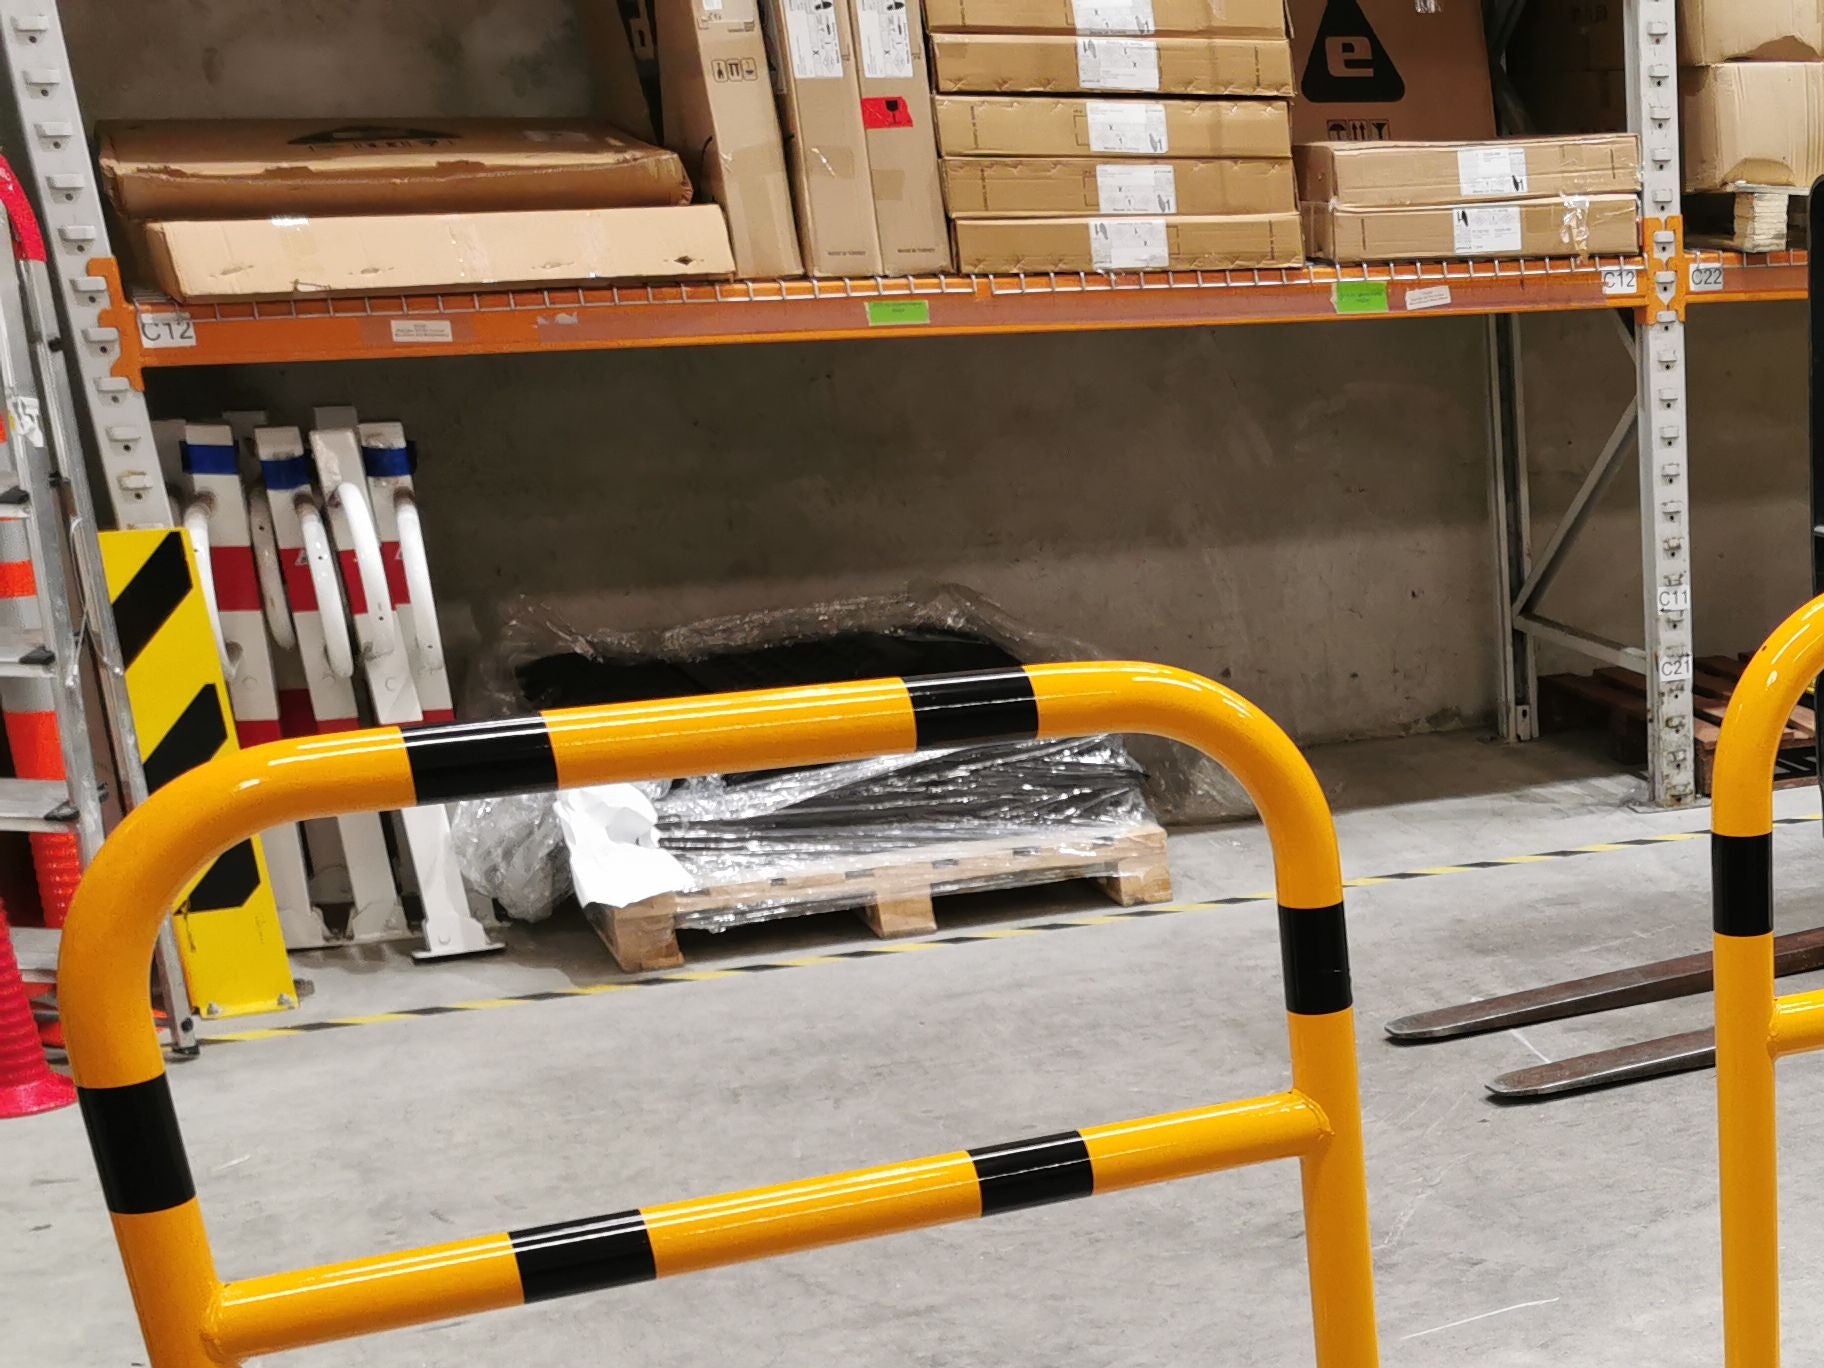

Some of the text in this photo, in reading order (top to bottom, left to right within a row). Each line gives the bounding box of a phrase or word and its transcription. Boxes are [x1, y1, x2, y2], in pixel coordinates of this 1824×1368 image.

[1603, 269, 1635, 288] C12
[1691, 267, 1722, 285] C22
[141, 320, 194, 341] C12
[1659, 590, 1688, 606] C11
[1661, 660, 1690, 676] C21
